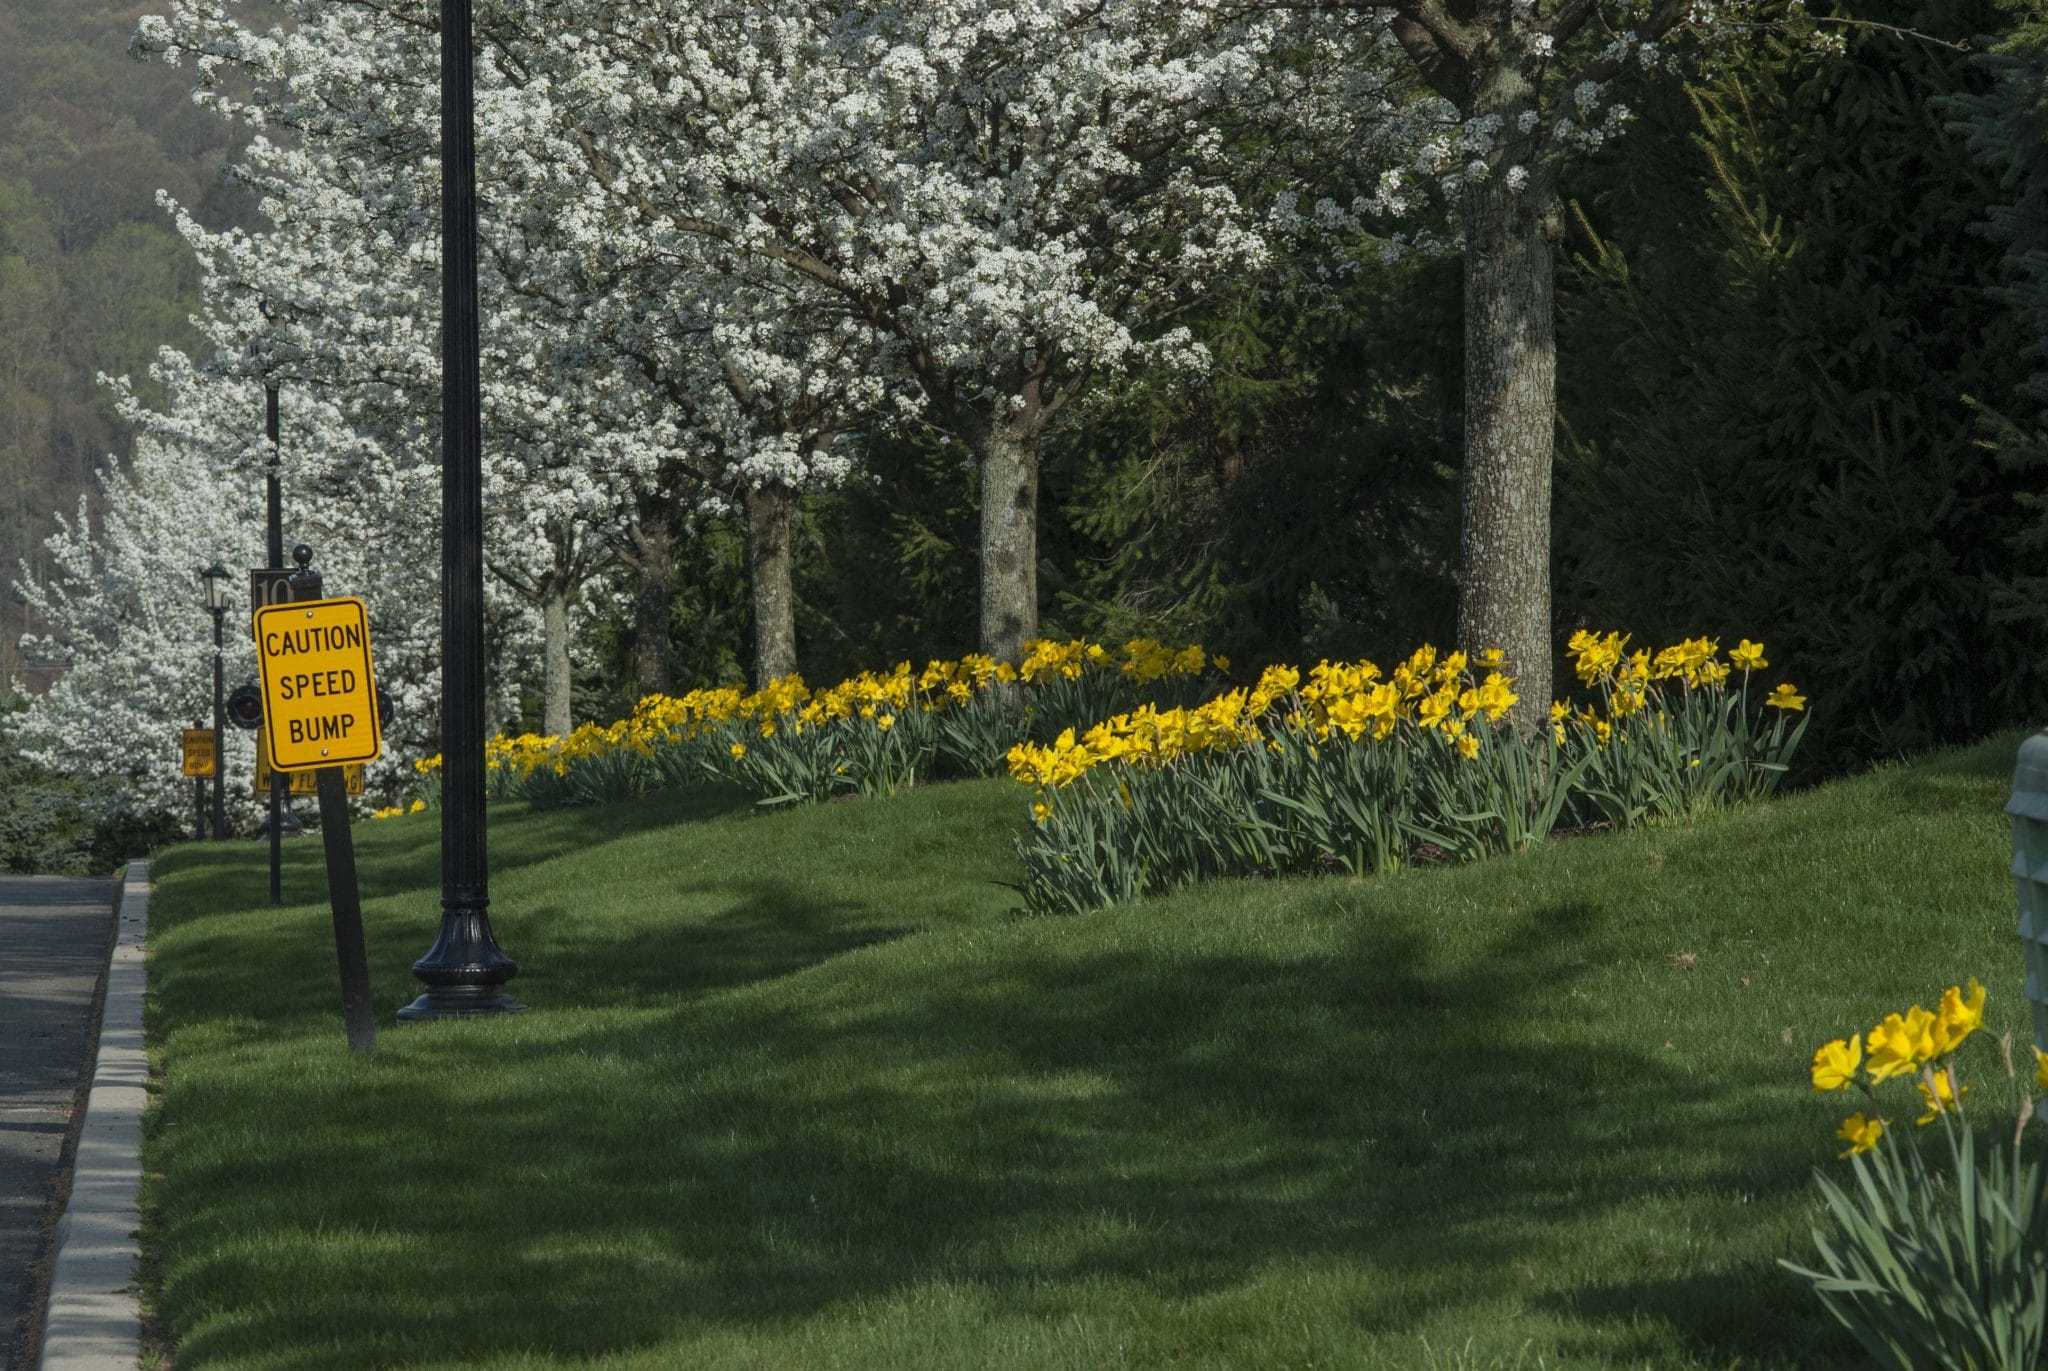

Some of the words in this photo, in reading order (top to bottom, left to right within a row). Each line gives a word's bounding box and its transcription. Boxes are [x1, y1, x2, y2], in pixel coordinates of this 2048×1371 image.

[266, 623, 361, 657] CAUTION
[280, 669, 356, 700] SPEED
[289, 713, 355, 744] BUMP
[184, 735, 213, 744] CAUTION
[188, 748, 210, 756] SPEED
[189, 759, 209, 769] BUMP
